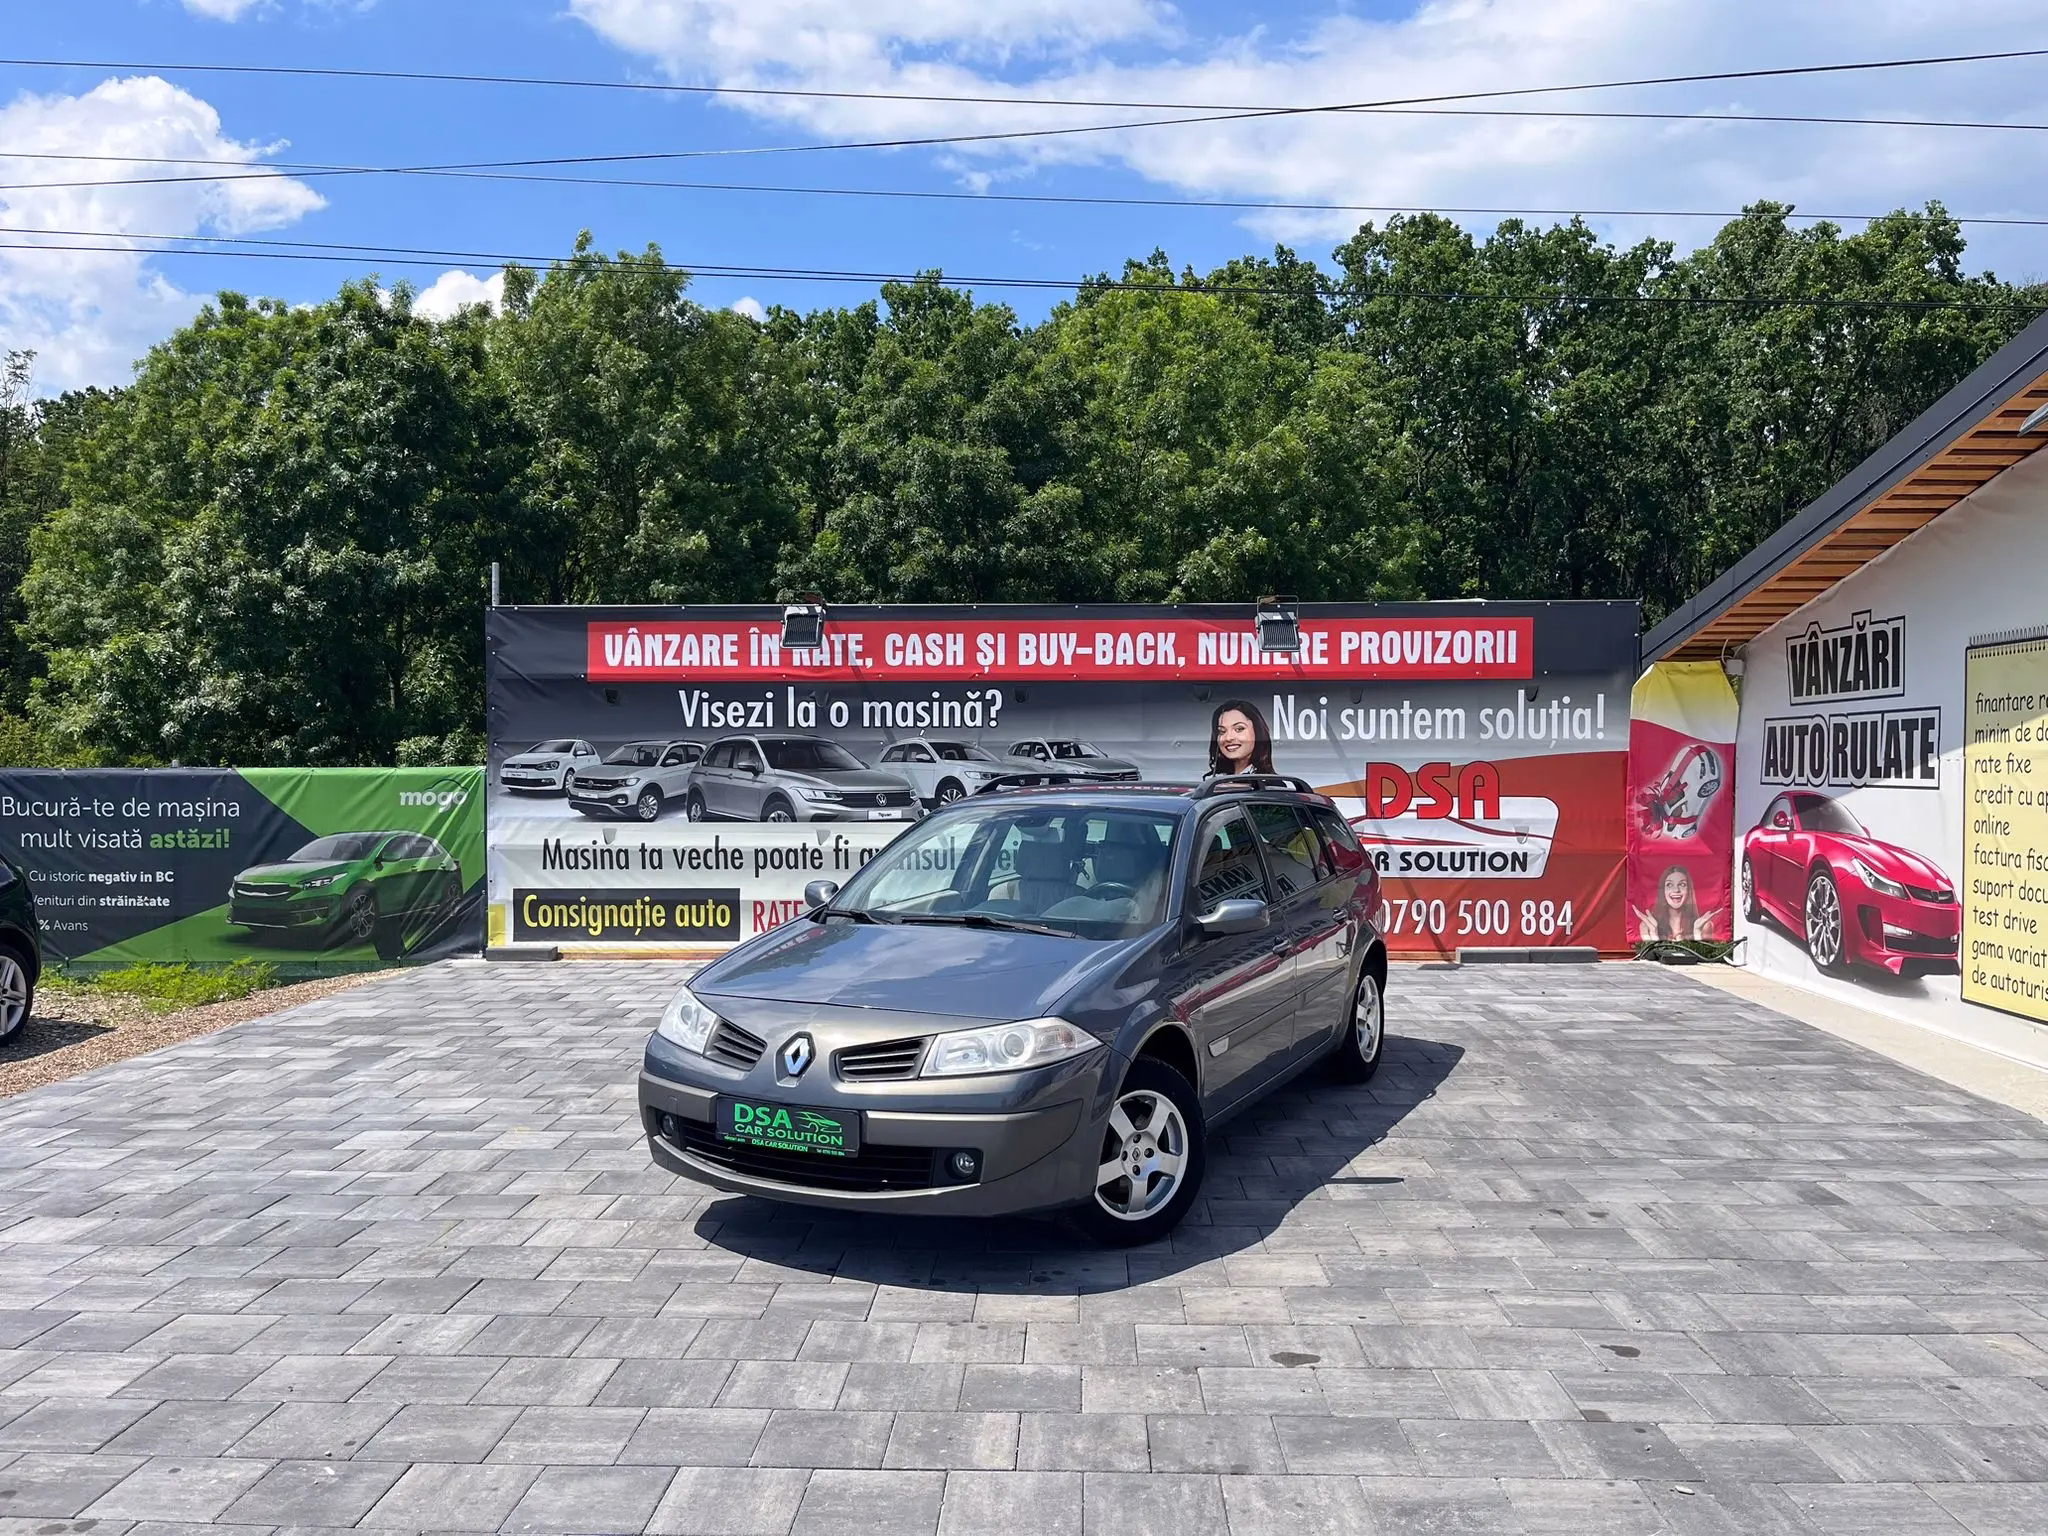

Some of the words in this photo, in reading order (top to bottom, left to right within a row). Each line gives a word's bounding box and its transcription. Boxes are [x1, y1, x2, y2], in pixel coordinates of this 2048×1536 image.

[605, 627, 738, 667] VÂNZARE
[749, 627, 780, 666] ÎN
[885, 633, 965, 666] CASH
[976, 633, 1006, 673] ȘI
[1018, 632, 1185, 668] BUY-BACK,
[1340, 630, 1517, 665] PROVIZORII
[1790, 621, 1900, 697] VÂNZĂRI
[678, 690, 774, 728] Visezi
[787, 686, 816, 728] la
[829, 701, 849, 728] o
[862, 689, 1003, 736] mașină?
[1975, 692, 2034, 715] finantare
[1273, 694, 1328, 740] Noi
[1340, 700, 1465, 740] suntem
[1479, 689, 1605, 749] soluția!
[1974, 723, 2011, 743] minim
[2015, 720, 2032, 742] de
[1764, 723, 1825, 778] AUTO
[1832, 717, 1935, 780] RULATE
[1974, 755, 2002, 774] rate
[2006, 752, 2032, 775] fixe
[400, 791, 468, 813] mogo
[1366, 761, 1500, 820] DSA
[1974, 783, 2013, 805] credit
[2018, 790, 2033, 806] cu
[2, 796, 114, 817] Bucură-te
[122, 797, 150, 817] de
[158, 799, 240, 822] mașina
[1974, 813, 2010, 836] online
[21, 829, 72, 848] mult
[78, 828, 142, 848] visată
[150, 828, 230, 849] astăzi!
[542, 838, 630, 870] Masina
[640, 843, 663, 870] ta
[673, 835, 743, 870] veche
[754, 843, 823, 878] poate
[833, 834, 849, 870] fi
[1400, 851, 1527, 872] SOLUTION
[1974, 843, 2022, 868] factura
[29, 870, 46, 882] Cu
[49, 870, 85, 882] istoric
[88, 871, 137, 884] negativ
[140, 871, 152, 882] in
[156, 870, 174, 882] BC
[77, 895, 96, 906] din
[1973, 878, 2014, 902] suport
[53, 919, 88, 931] Avans
[523, 894, 666, 936] Consignație
[675, 901, 731, 928] auto
[1457, 899, 1510, 935] 500
[1520, 899, 1573, 936] 884
[1972, 905, 1999, 927] test
[2003, 909, 2038, 934] drive
[1972, 939, 2004, 960] gama
[1972, 964, 1987, 986] de
[734, 1103, 793, 1129] DSA
[734, 1123, 763, 1136] CAR
[767, 1129, 843, 1146] SOLUTION
[765, 1140, 777, 1148] CAR
[777, 1142, 808, 1152] SOLUTION
